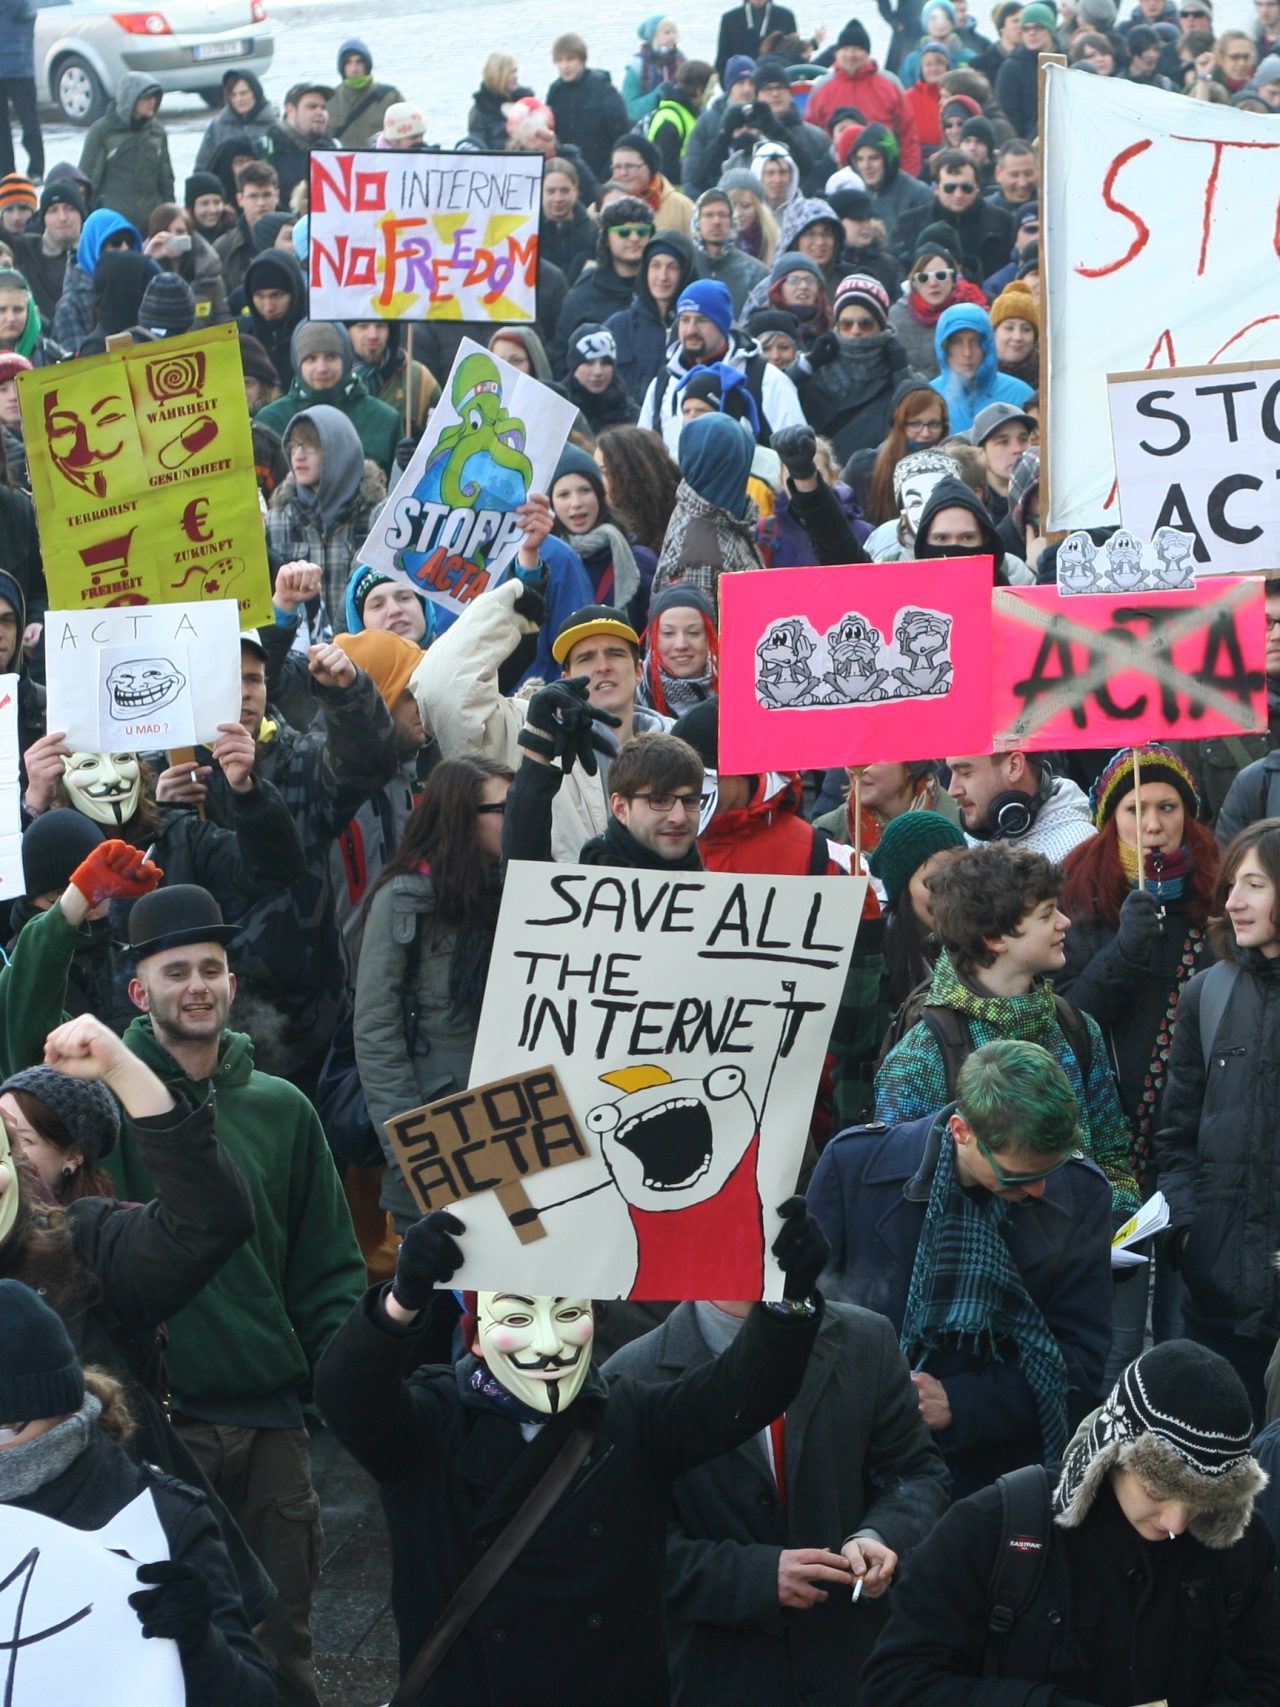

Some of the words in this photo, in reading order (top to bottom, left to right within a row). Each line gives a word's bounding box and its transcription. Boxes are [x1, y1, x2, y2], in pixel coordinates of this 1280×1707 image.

[400, 169, 543, 210] INTERNET
[379, 217, 539, 306] FREEDOM
[147, 398, 218, 424] WAHRHEIT
[149, 458, 232, 487] GESUNDHEIT
[66, 501, 138, 527] TERRORIST
[385, 496, 527, 560] STOPP
[173, 538, 234, 563] ZUKUNFT
[81, 576, 143, 600] FREIHEIT
[416, 546, 491, 603] ACTA
[60, 613, 199, 649] ACTA
[1014, 605, 1265, 728] ACTA
[125, 725, 134, 735] U
[135, 724, 161, 734] MAD
[162, 723, 170, 732] ?
[525, 874, 705, 933] SAVE
[706, 884, 844, 952] ALL
[513, 951, 643, 997] THE
[518, 993, 826, 1059] INTERNET
[393, 1072, 559, 1163] STOP
[410, 1116, 586, 1209] ACTA
